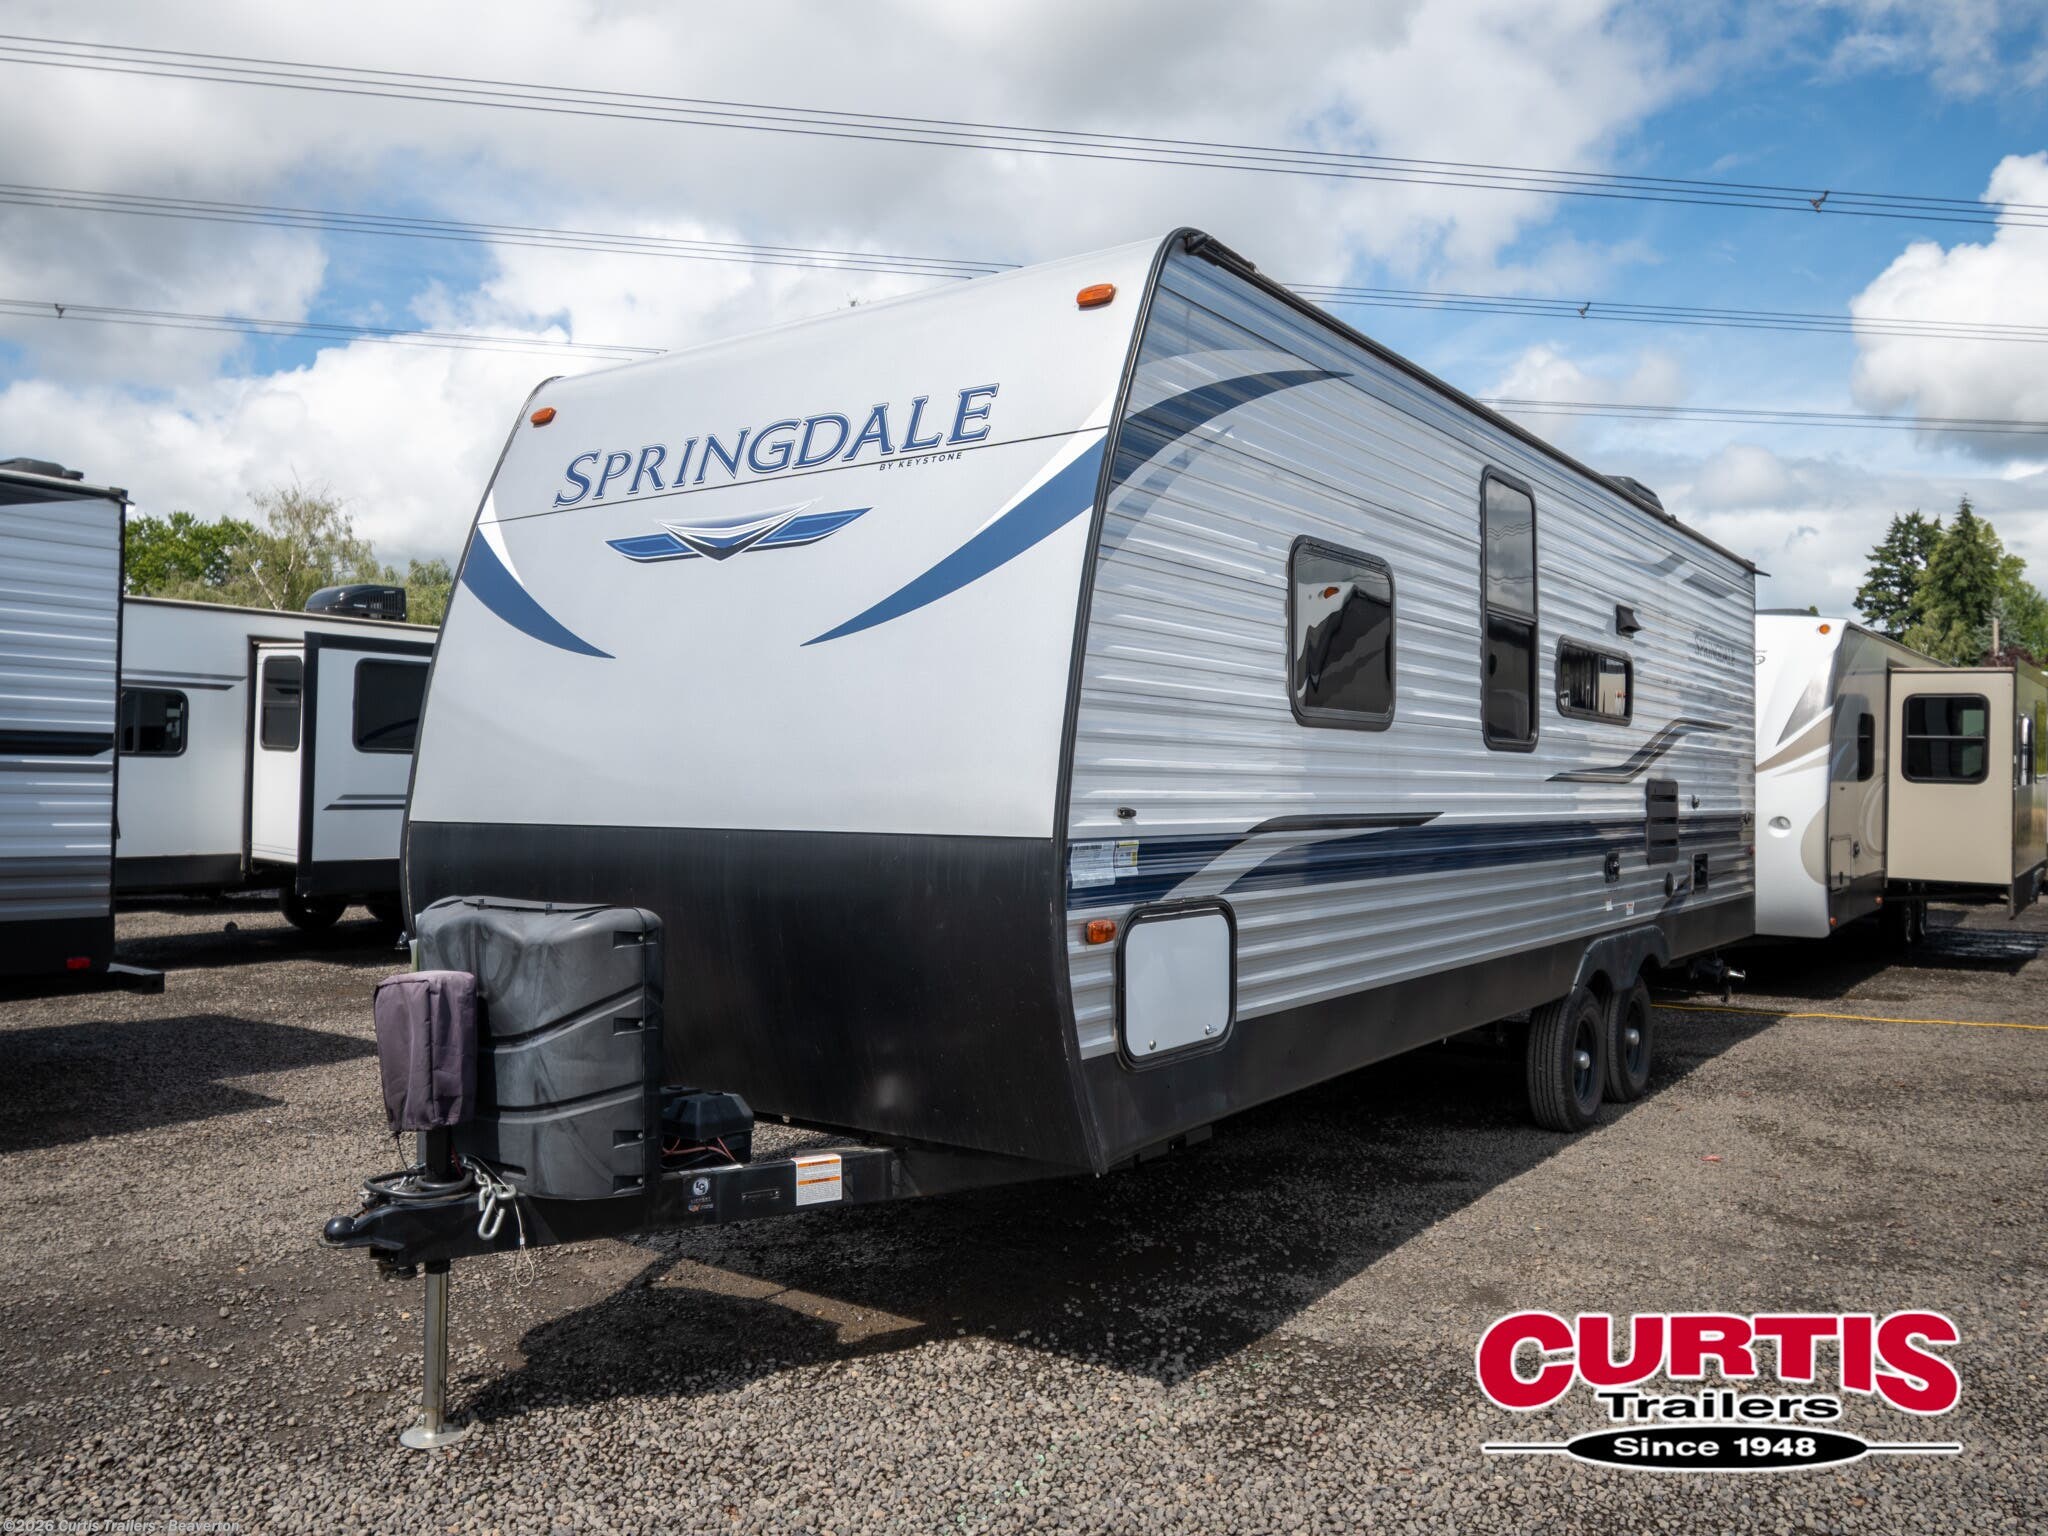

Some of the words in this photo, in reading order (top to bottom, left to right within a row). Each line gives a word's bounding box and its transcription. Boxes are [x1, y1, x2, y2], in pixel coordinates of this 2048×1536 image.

[552, 382, 999, 508] SPRINGDALE
[879, 462, 894, 471] BY
[898, 451, 962, 468] KEYSTONE
